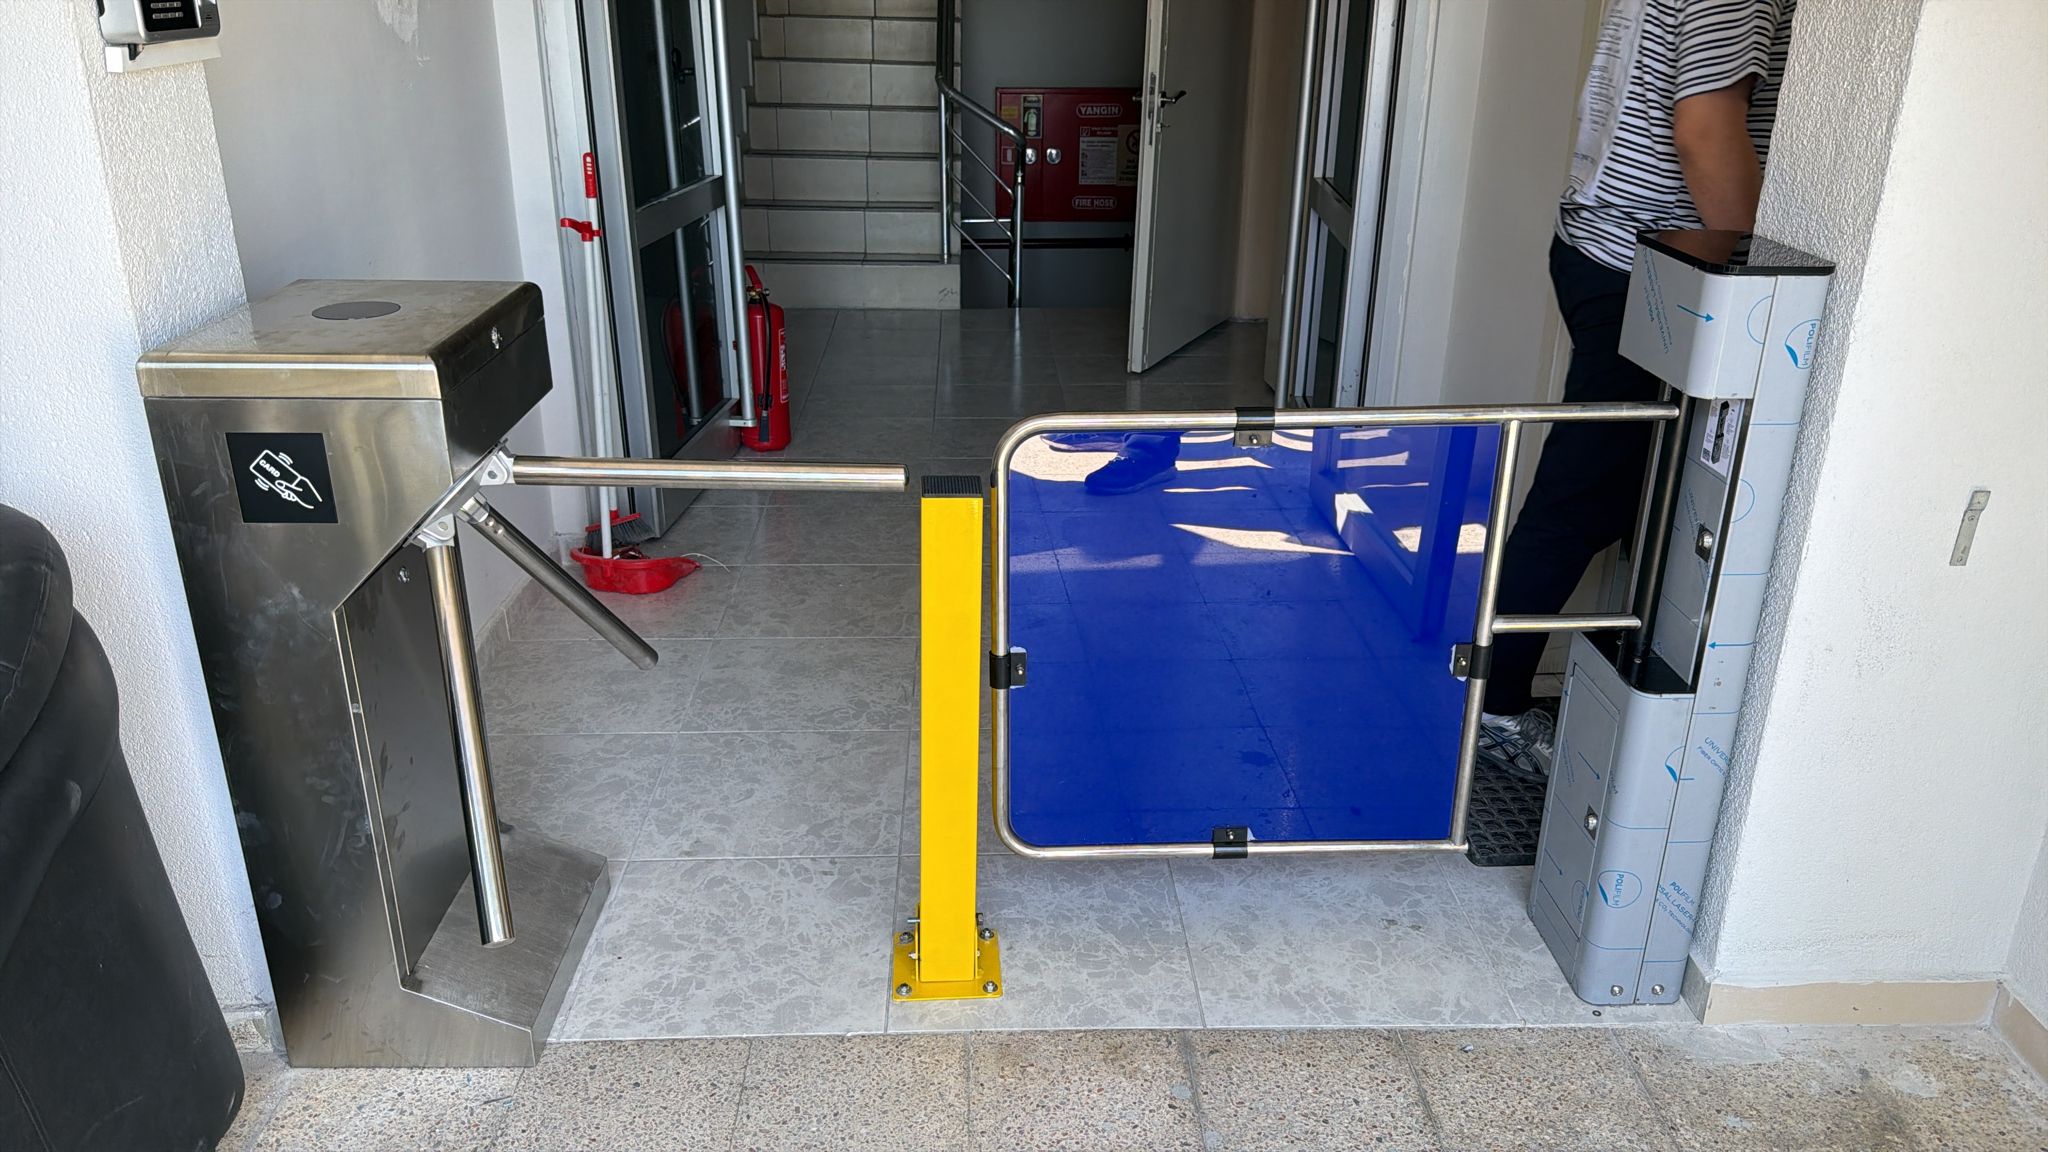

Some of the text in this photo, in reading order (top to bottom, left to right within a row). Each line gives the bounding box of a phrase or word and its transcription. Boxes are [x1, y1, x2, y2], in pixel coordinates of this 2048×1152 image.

[1080, 106, 1119, 115] YANGIN
[1075, 198, 1114, 208] FIRE HOSE
[1802, 322, 1817, 366] POLIFILM
[259, 459, 281, 478] CARD
[1612, 873, 1625, 906] POLIFILM
